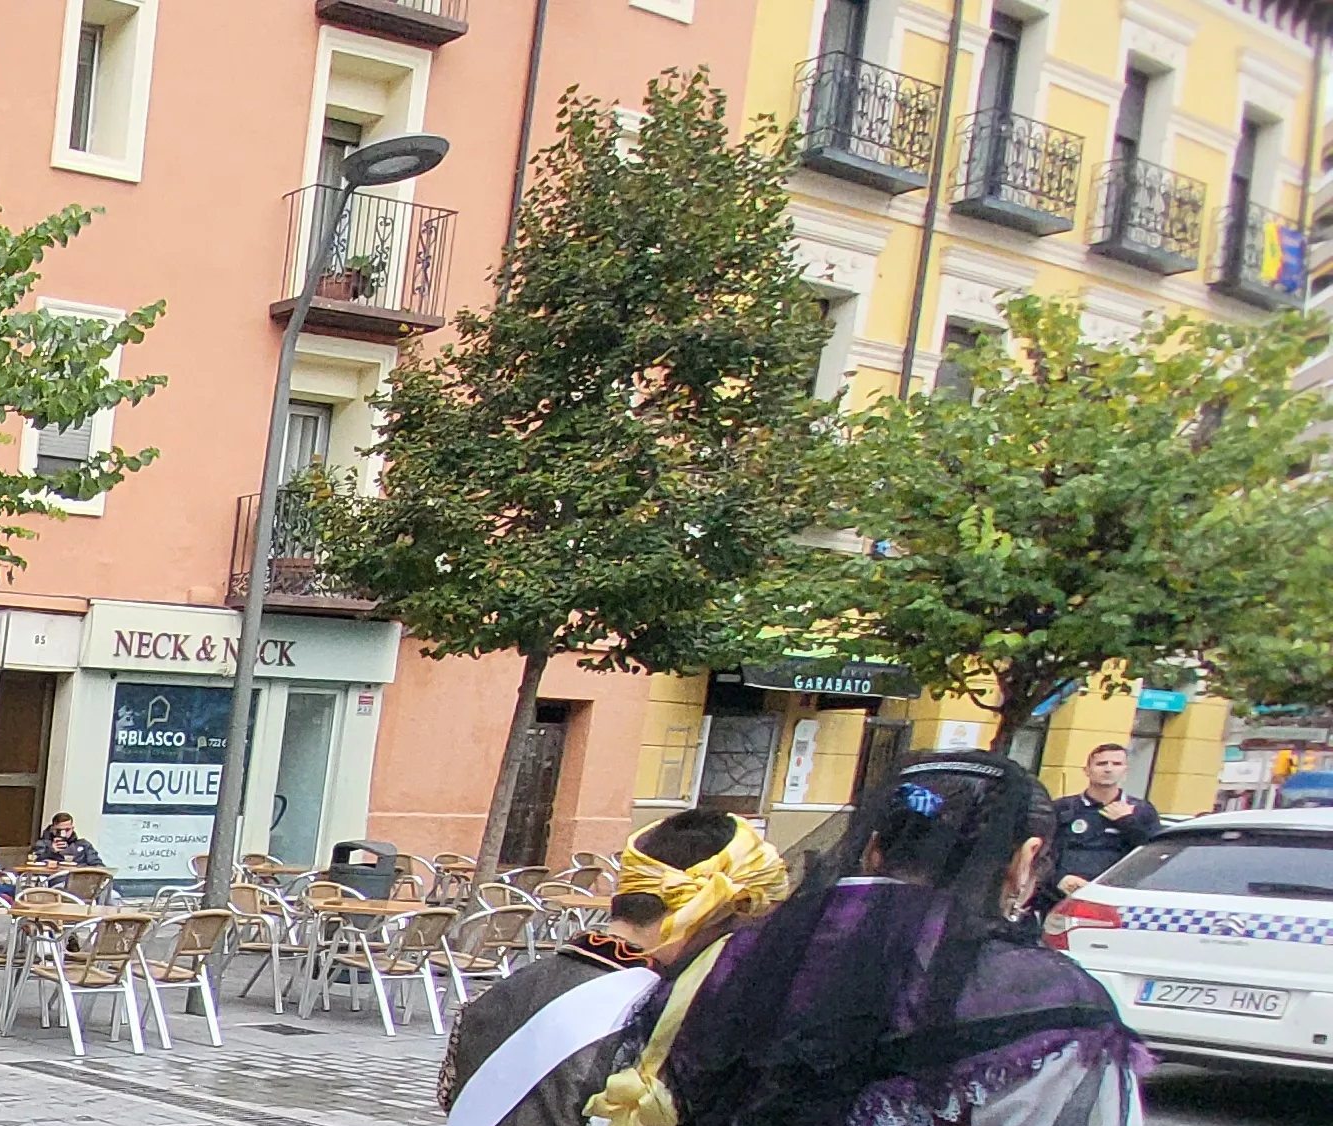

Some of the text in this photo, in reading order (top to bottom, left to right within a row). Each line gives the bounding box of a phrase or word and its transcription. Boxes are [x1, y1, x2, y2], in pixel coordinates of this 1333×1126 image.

[113, 629, 297, 667] NECK & NCK
[793, 674, 872, 694] GARABATO
[117, 729, 186, 747] RBLASCO
[113, 768, 220, 802] ALQUILE
[140, 835, 174, 844] ESPACIO
[137, 863, 160, 872] BAÑO
[1156, 984, 1279, 1012] 2775 HNG
